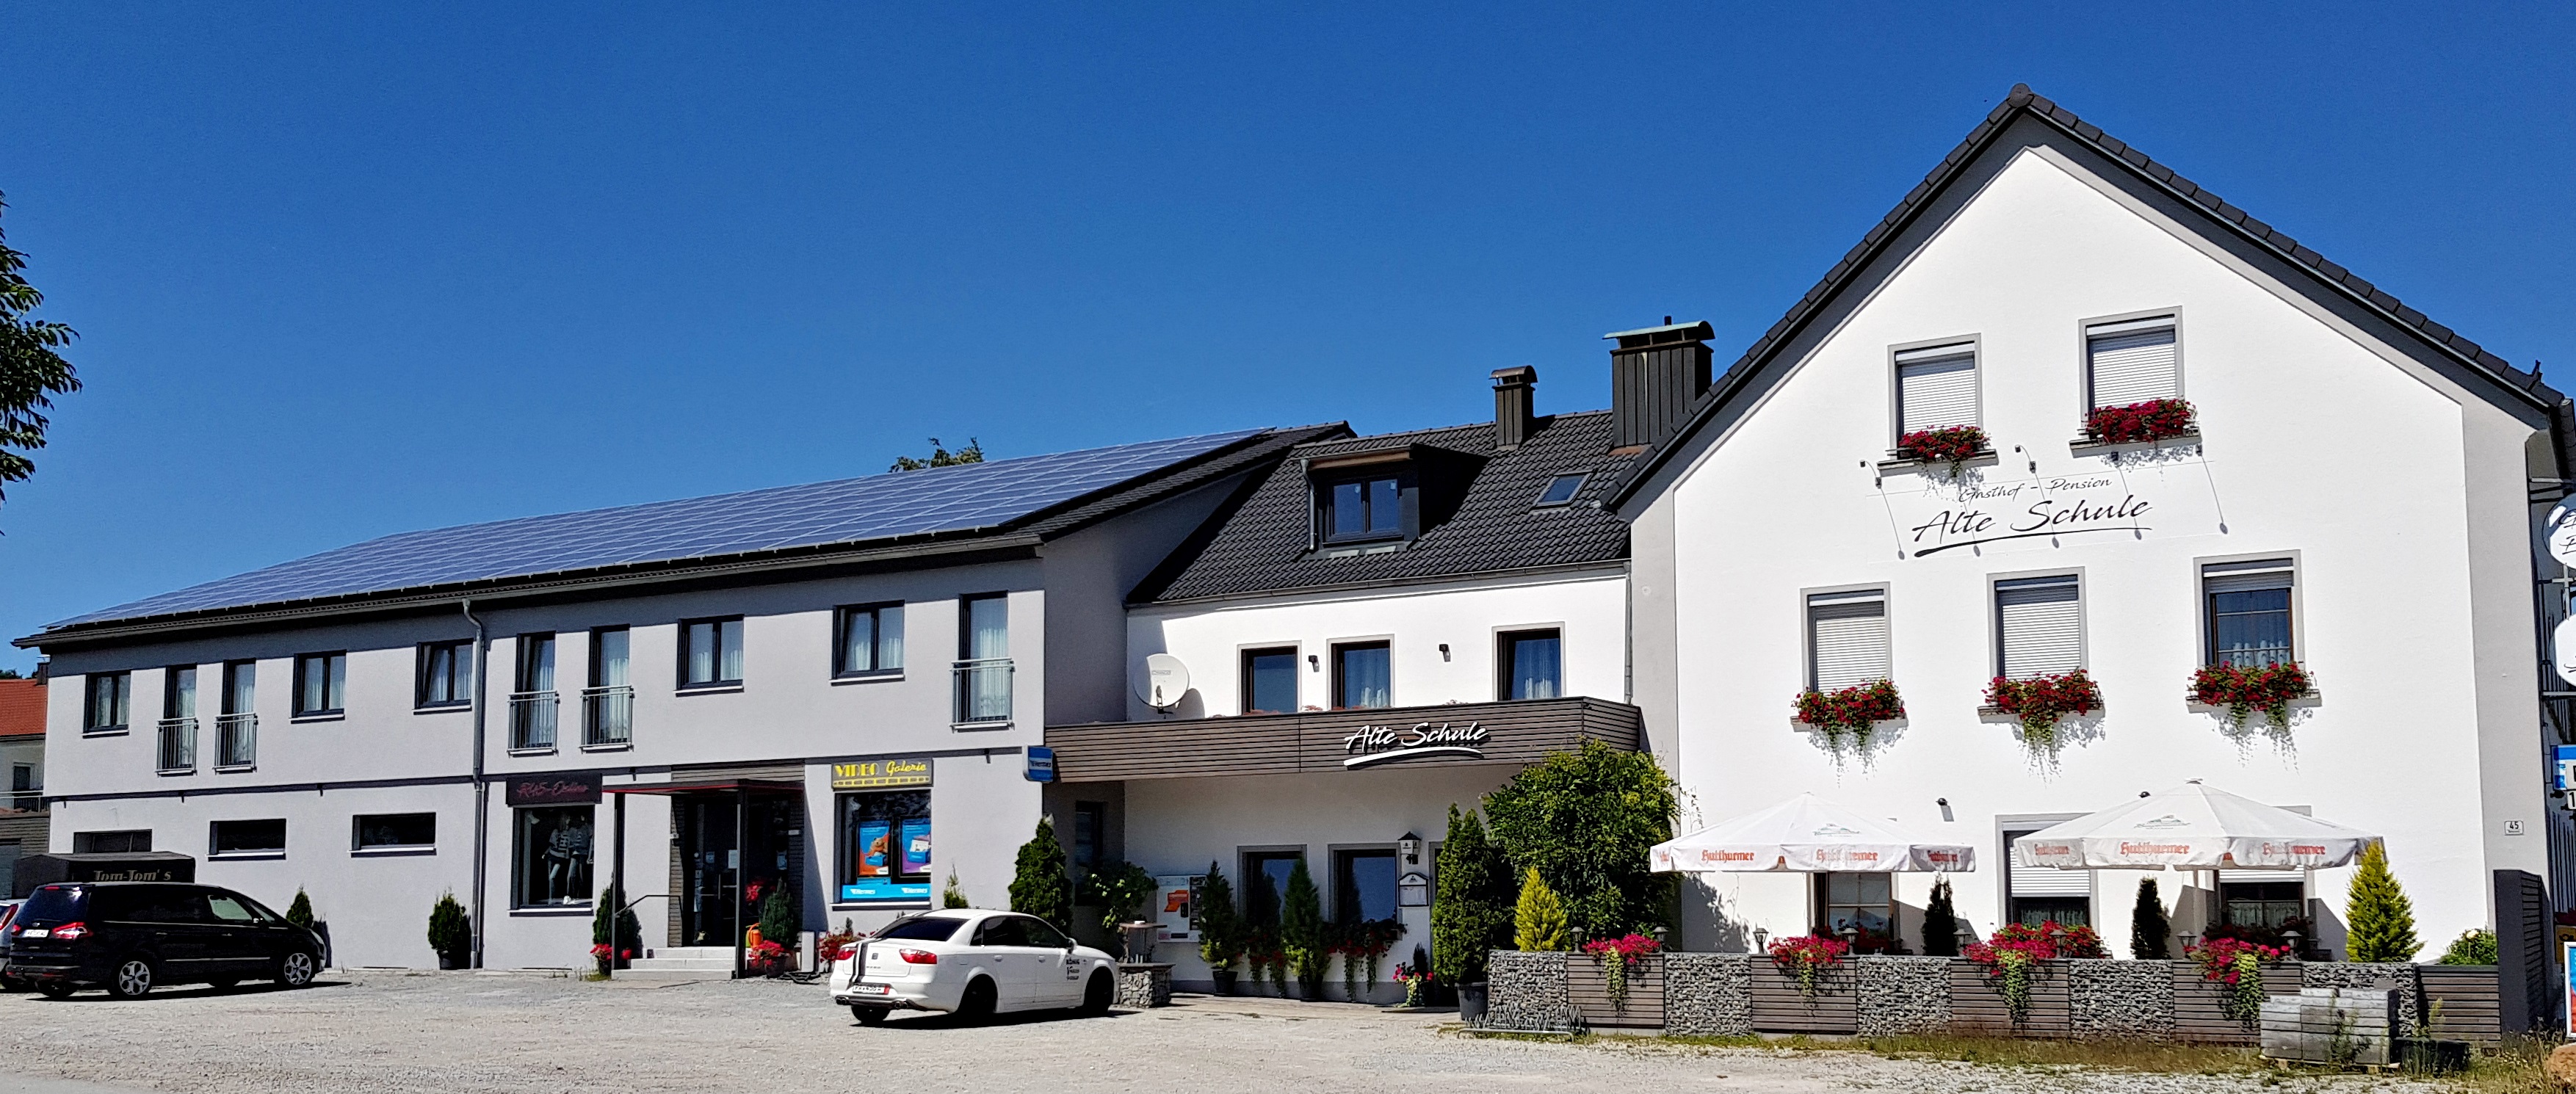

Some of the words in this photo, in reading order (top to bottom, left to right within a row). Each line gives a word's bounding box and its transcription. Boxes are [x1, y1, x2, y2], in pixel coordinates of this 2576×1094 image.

[1959, 483, 2025, 503] Gasthof
[2045, 478, 2113, 494] Pension
[1912, 510, 1997, 544] Alte
[2011, 494, 2153, 532] Schule
[1344, 725, 1398, 753] Alte
[1400, 722, 1488, 747] Schule
[834, 763, 880, 778] VIDEO
[886, 760, 927, 777] Galerie
[2509, 821, 2519, 830] 45
